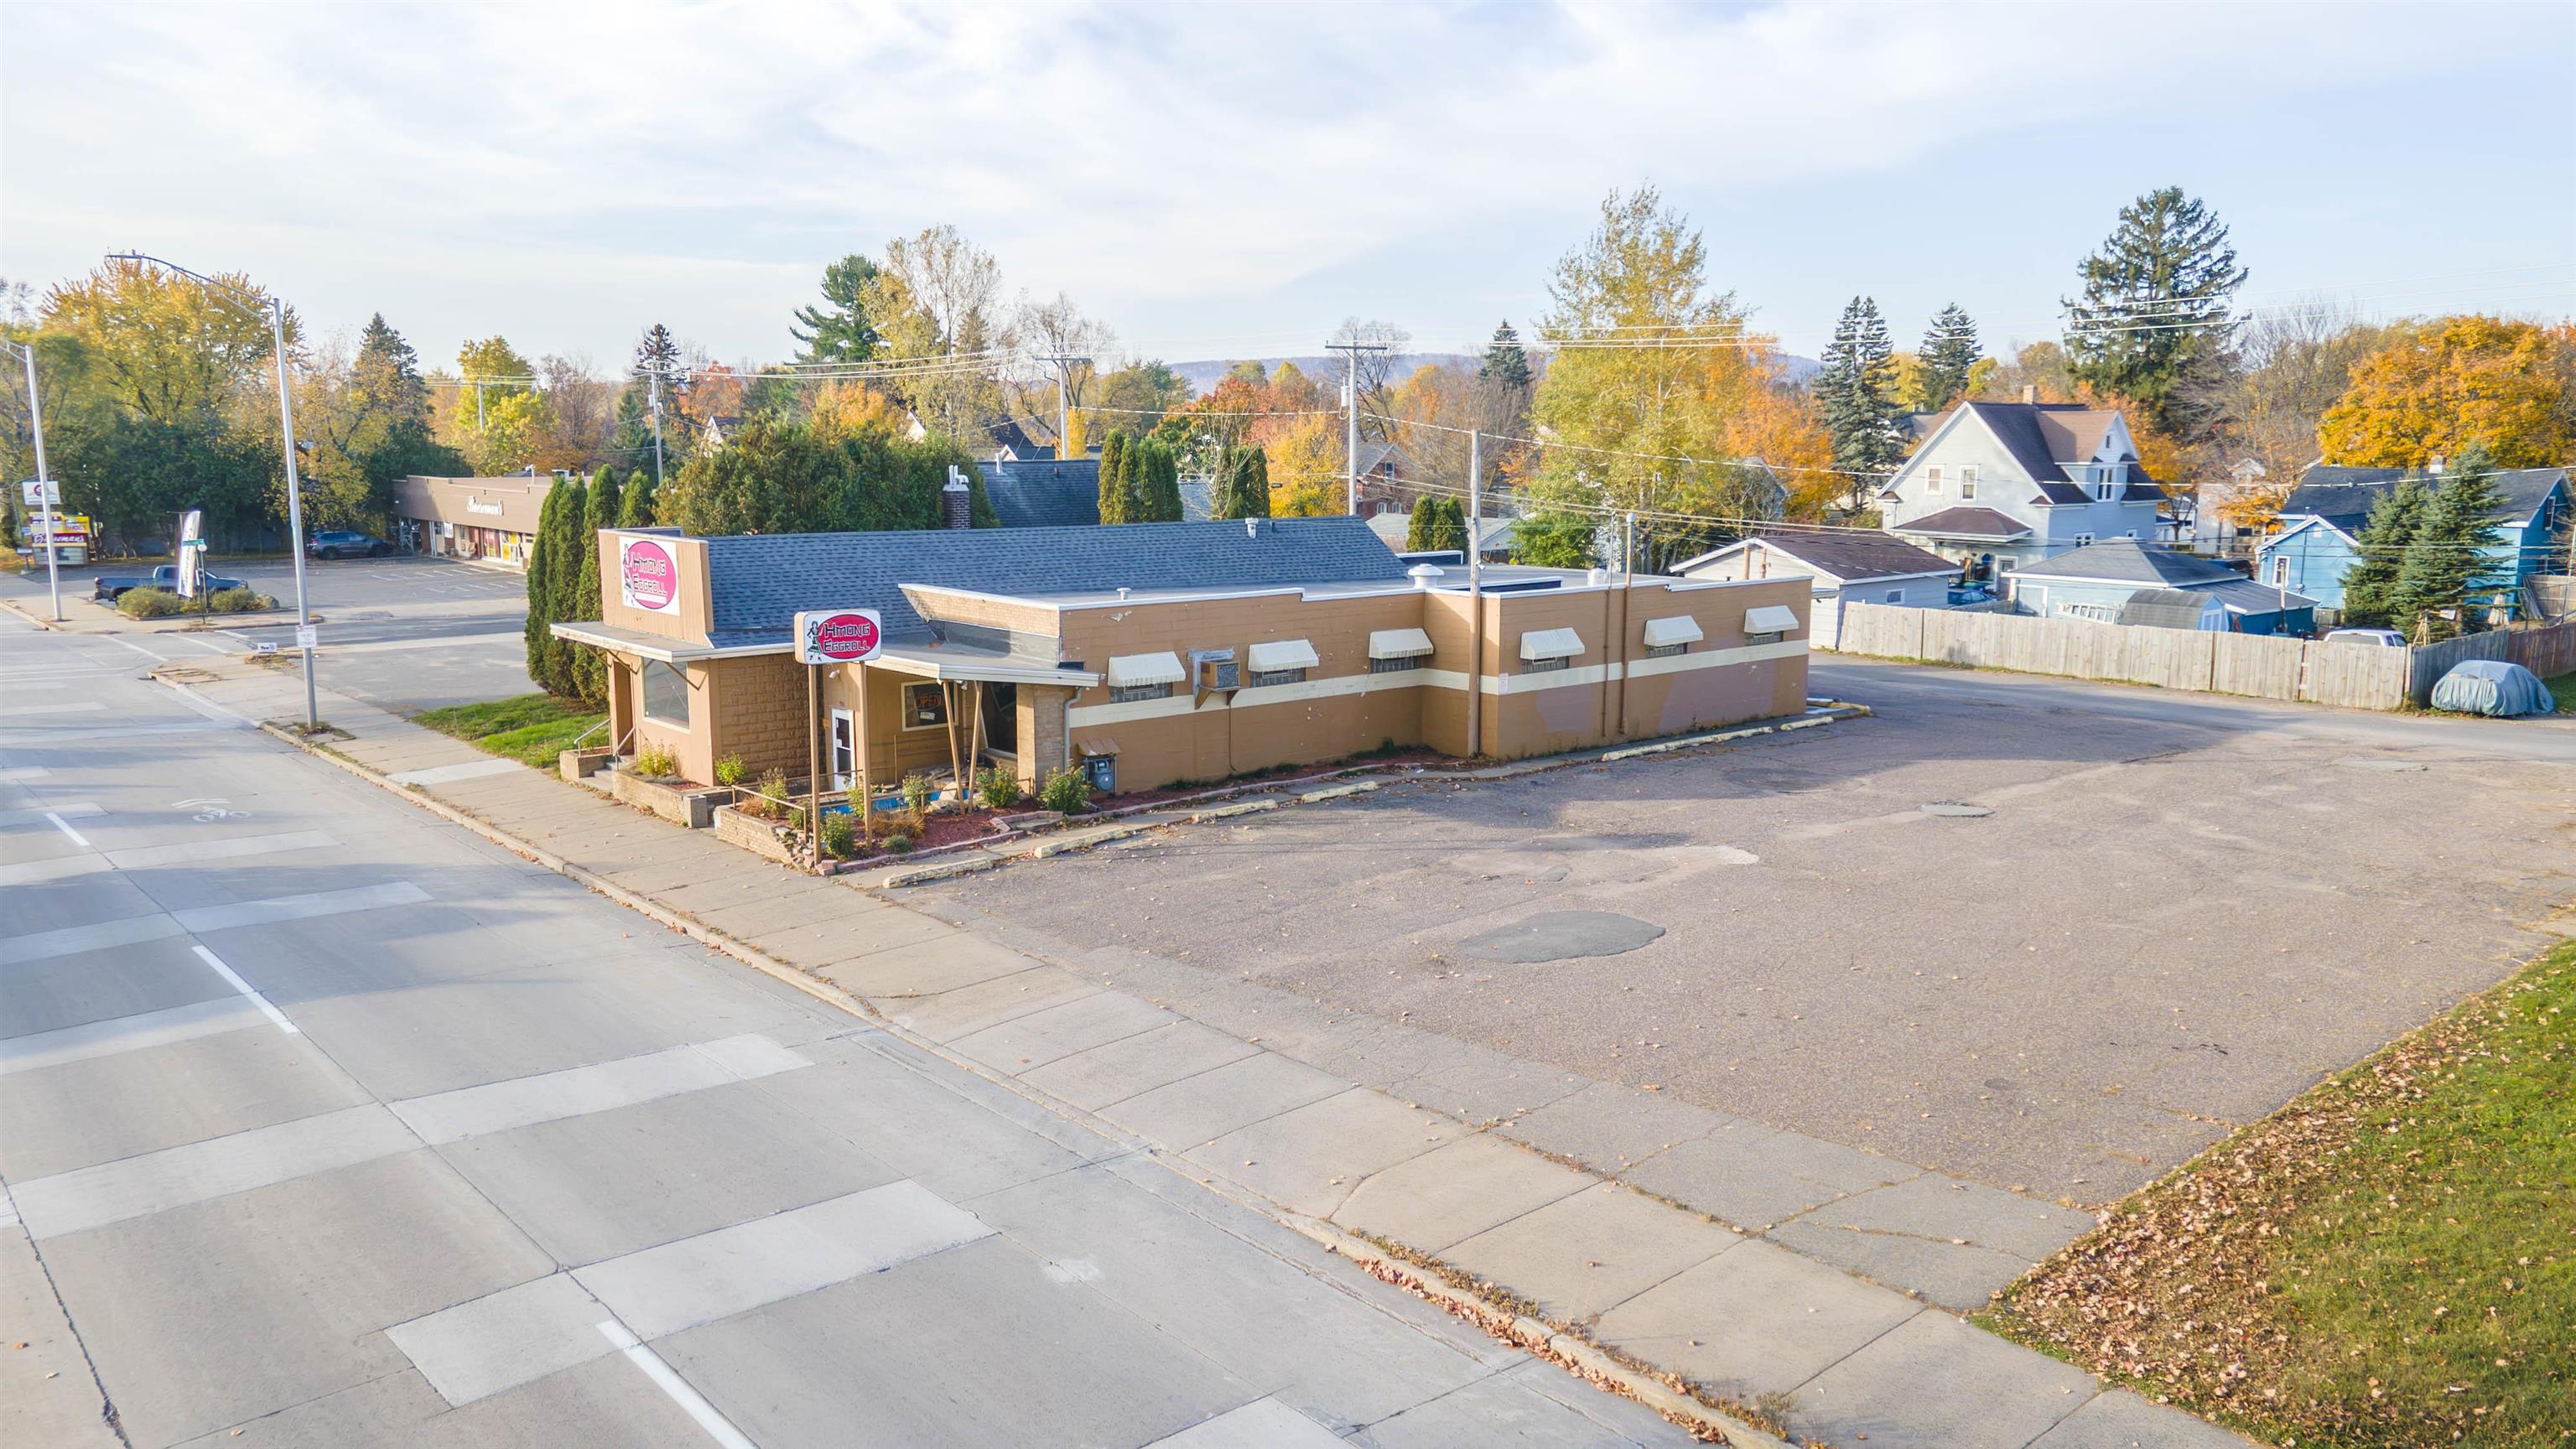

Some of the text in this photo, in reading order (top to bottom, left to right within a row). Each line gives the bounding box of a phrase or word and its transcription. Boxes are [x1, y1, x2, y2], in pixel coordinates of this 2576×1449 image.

[631, 551, 667, 577] HMONG
[632, 573, 667, 595] EGGROLL
[823, 622, 870, 637] HMONG
[823, 638, 870, 653] EGGROLL
